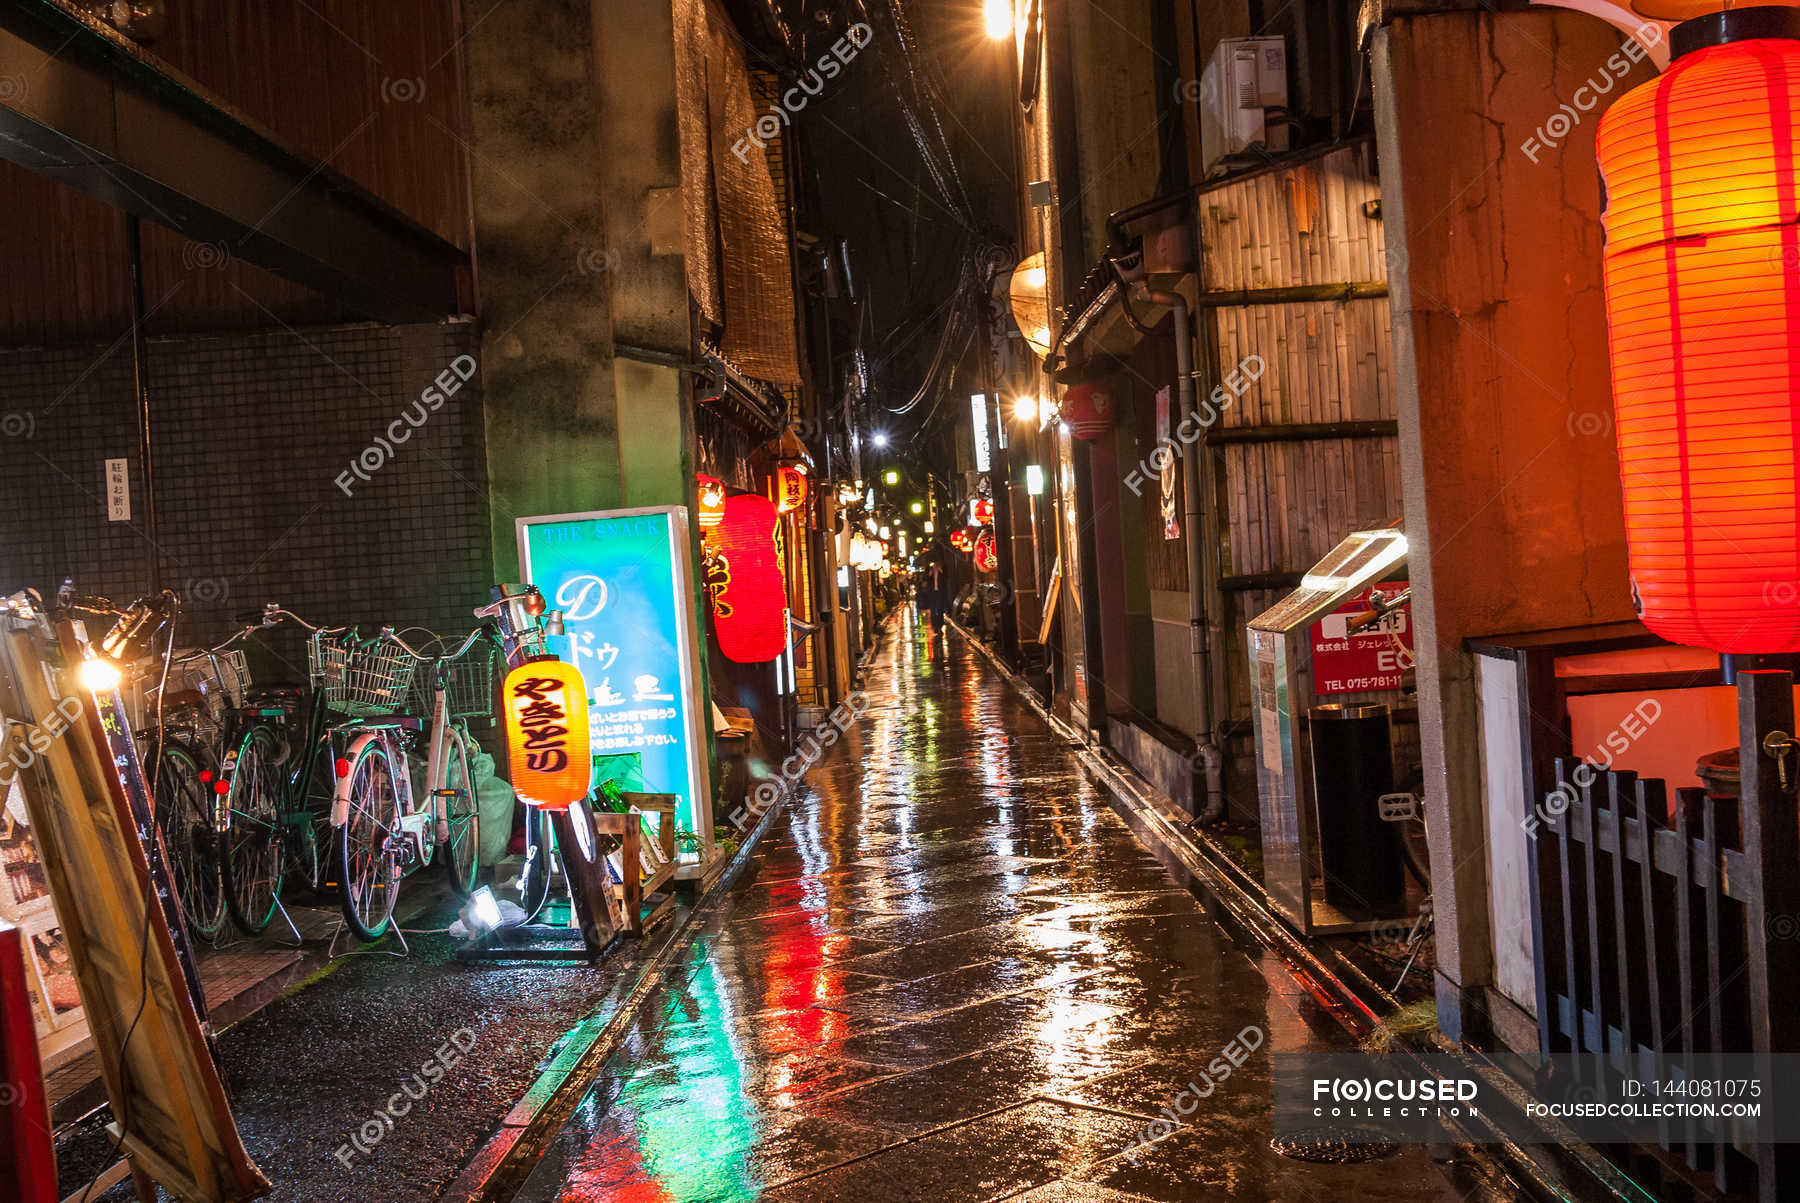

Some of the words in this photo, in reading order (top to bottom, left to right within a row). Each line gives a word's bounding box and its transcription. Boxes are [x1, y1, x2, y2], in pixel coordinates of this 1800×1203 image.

[543, 526, 583, 544] THE
[595, 519, 659, 539] SNACK
[1316, 642, 1350, 652] 株式会社
[1324, 679, 1345, 691] TEL
[513, 677, 569, 773] やきとり
